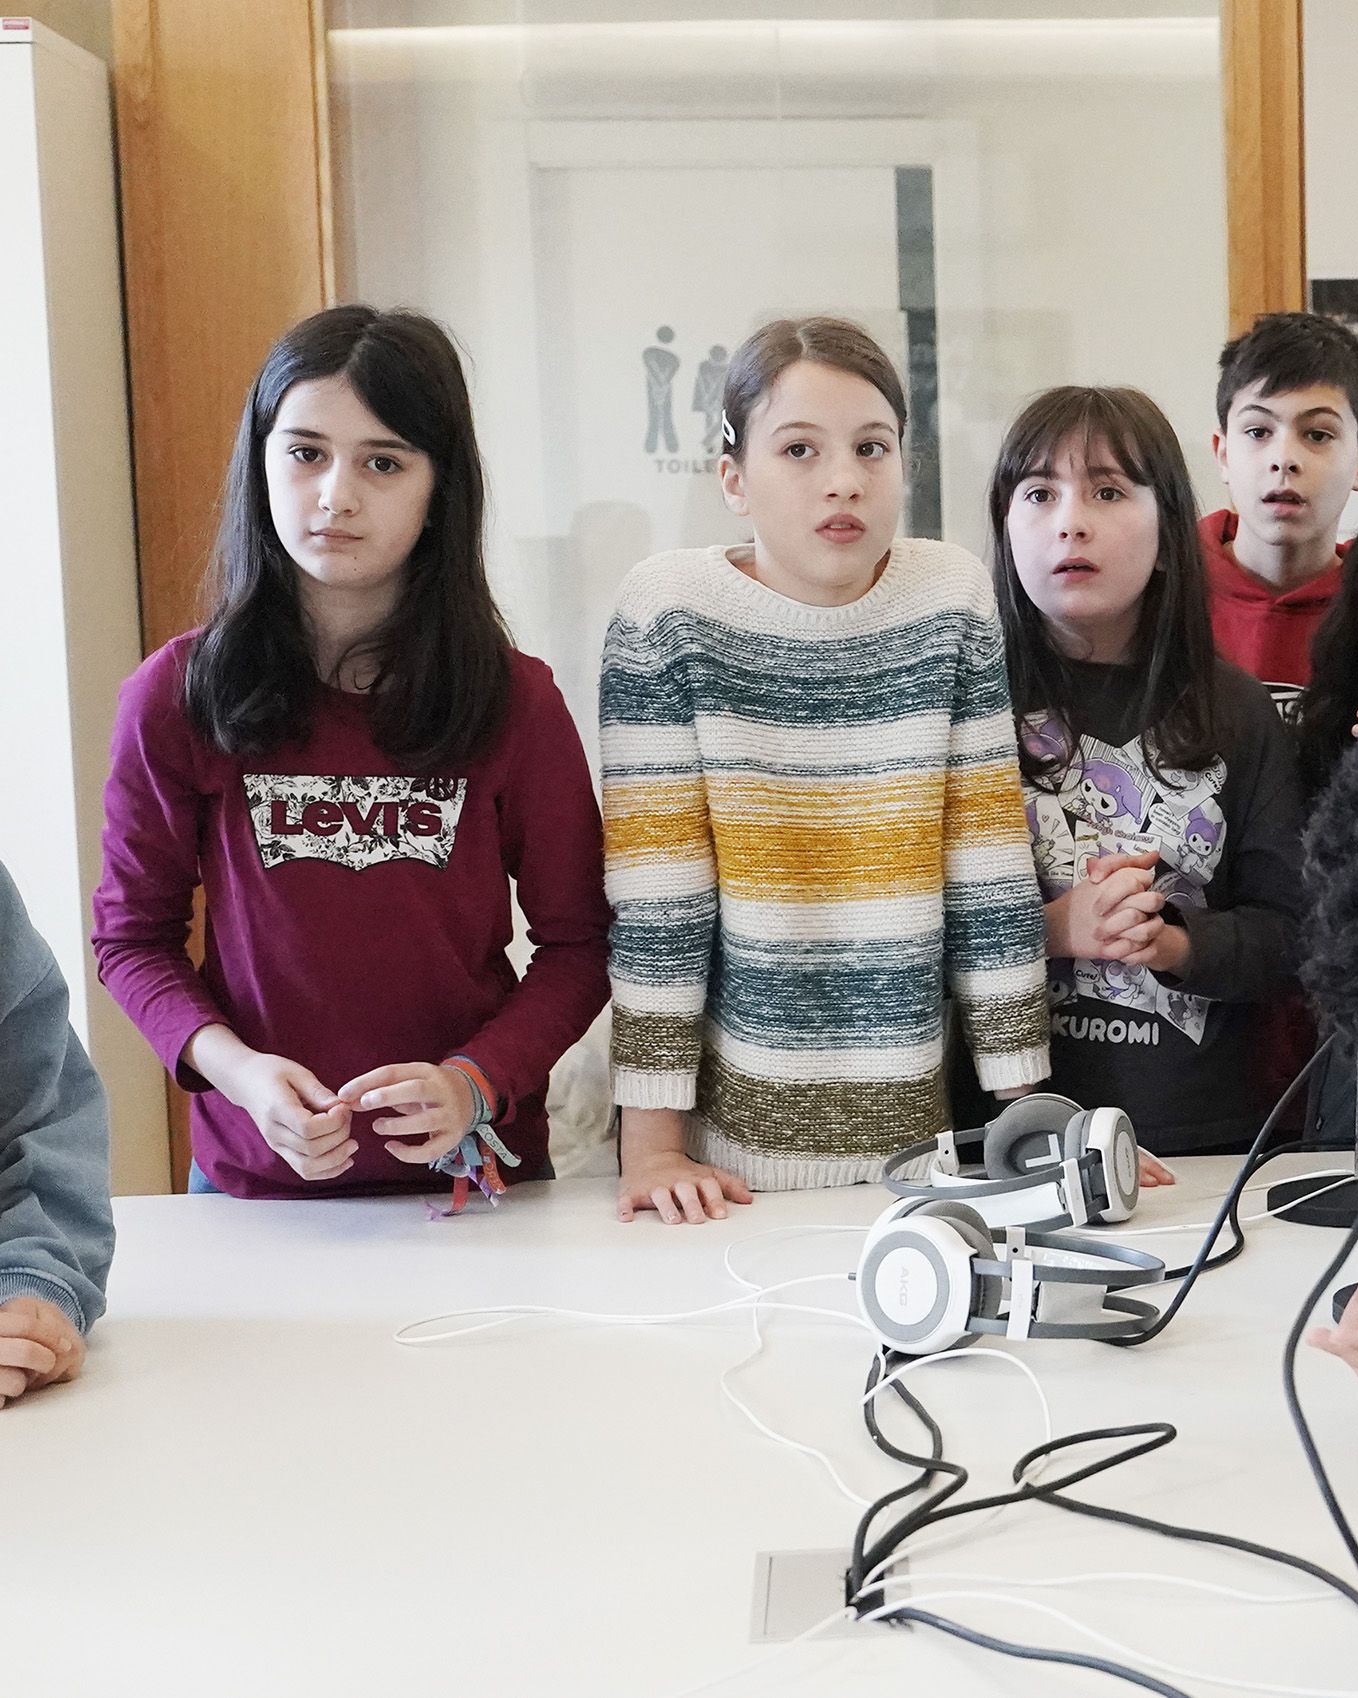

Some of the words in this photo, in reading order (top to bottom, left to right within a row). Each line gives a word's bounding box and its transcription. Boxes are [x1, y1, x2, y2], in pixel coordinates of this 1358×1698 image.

[655, 458, 717, 474] TOILE
[1052, 1012, 1160, 1046] KUROMI
[480, 1126, 508, 1159] COSTA
[898, 1266, 910, 1307] AKG
